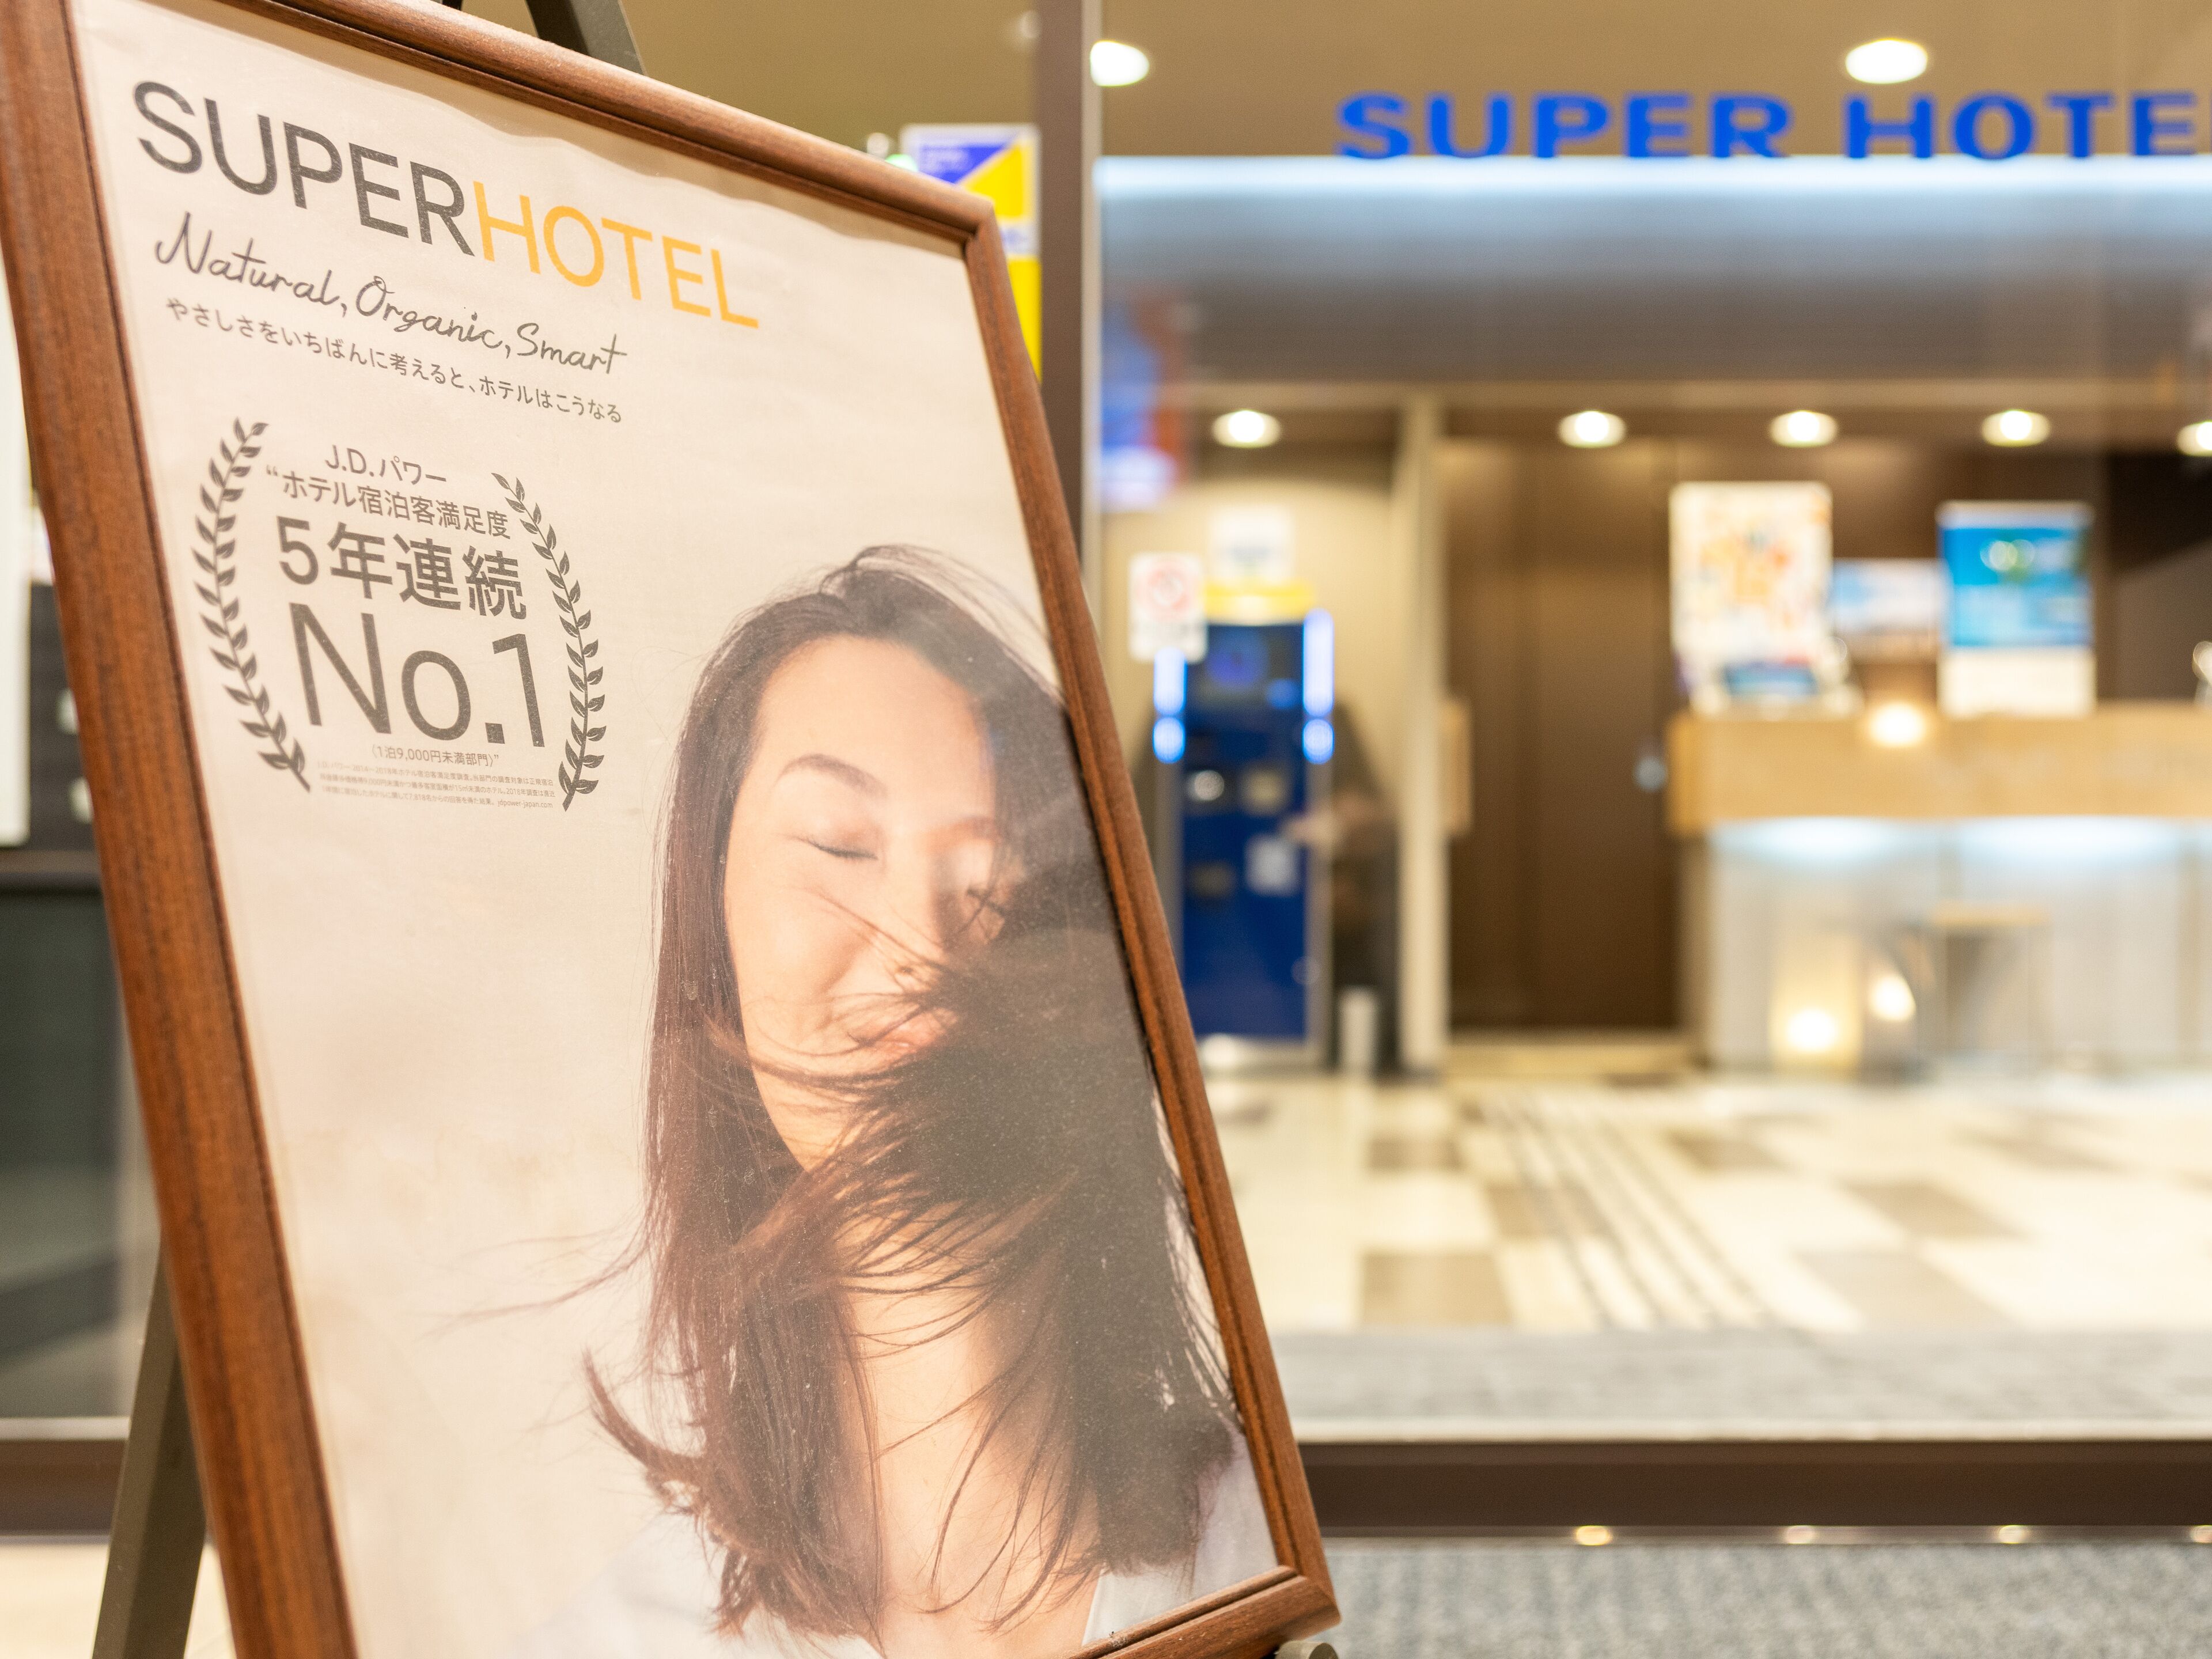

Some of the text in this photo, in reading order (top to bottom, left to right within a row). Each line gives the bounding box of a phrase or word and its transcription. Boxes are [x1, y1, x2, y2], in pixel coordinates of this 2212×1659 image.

[1335, 90, 2212, 160] SUPER HOTE
[132, 81, 759, 329] SUPERHOTEL
[165, 297, 622, 425] やさしさをいちばんに考えると、ホテルはこうなる
[515, 321, 627, 375] Smart
[276, 514, 527, 620] 5年連続
[289, 602, 545, 748] No.1
